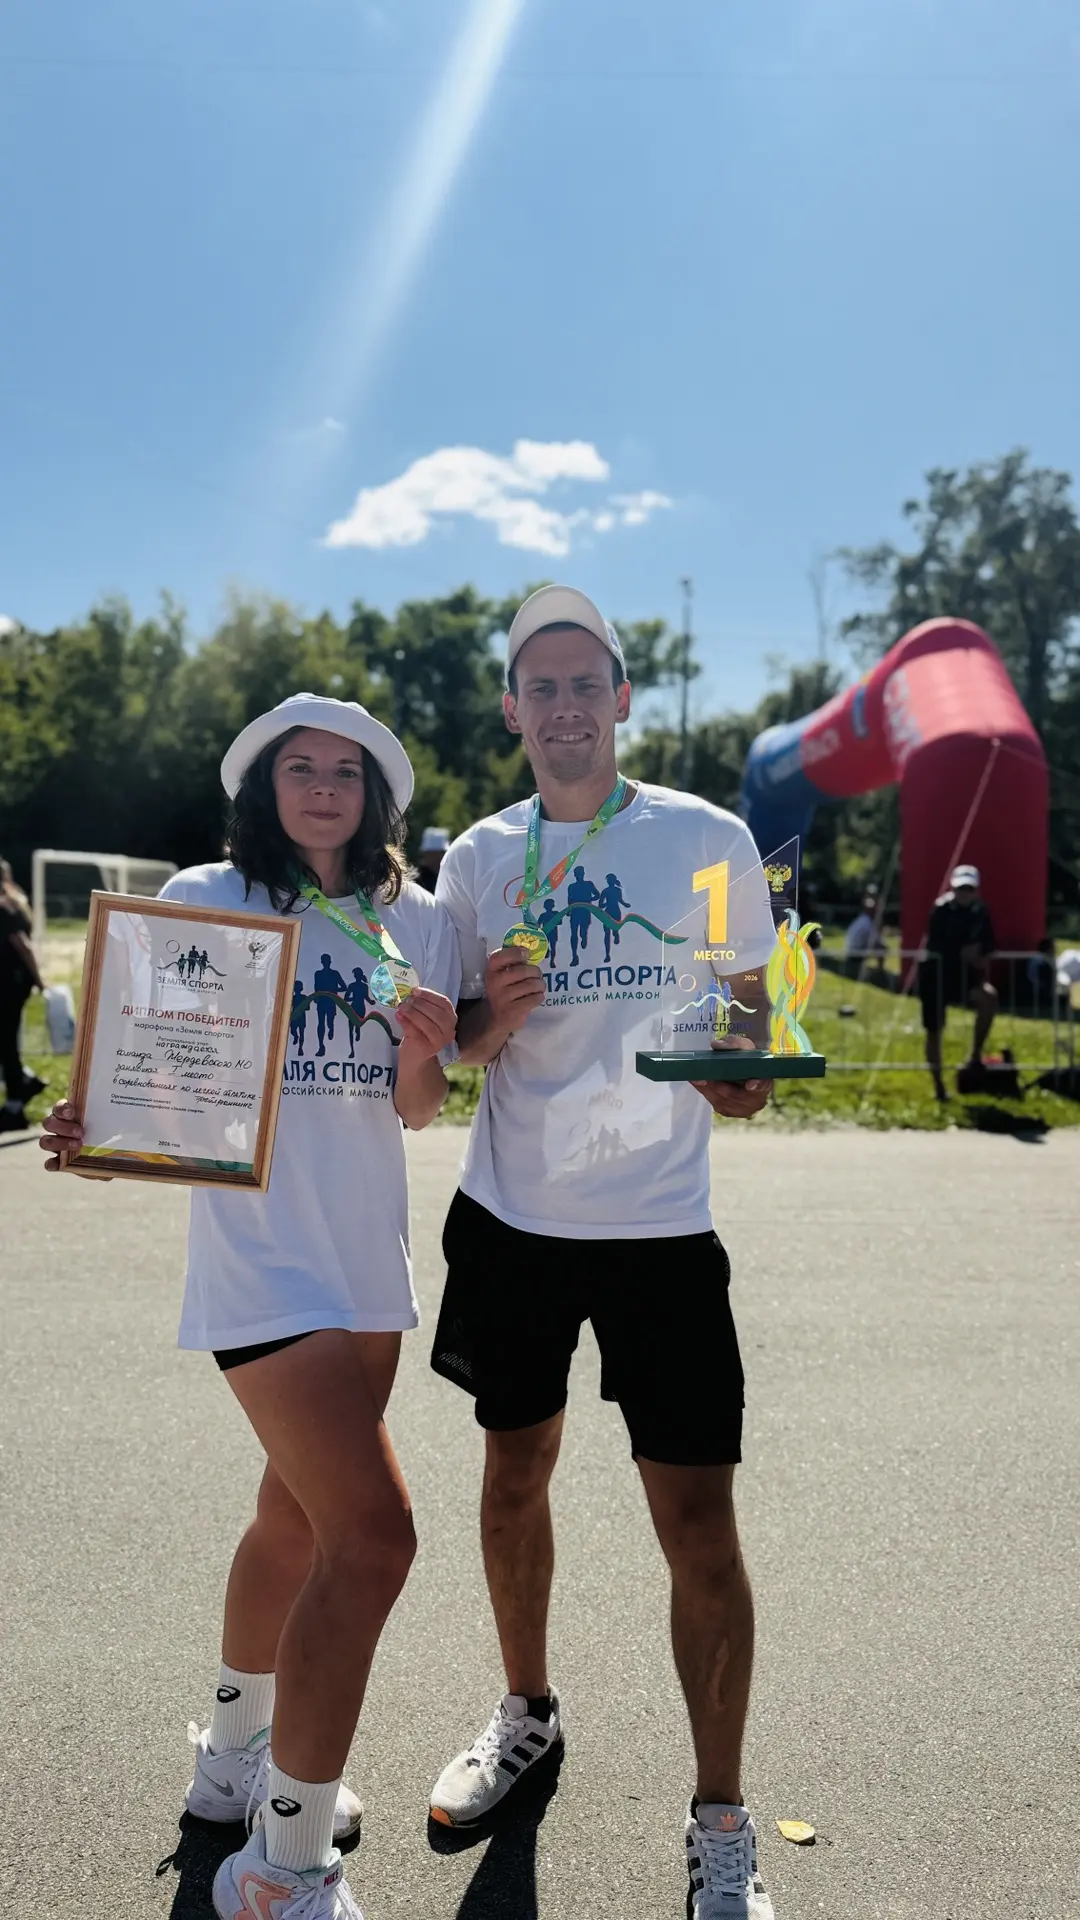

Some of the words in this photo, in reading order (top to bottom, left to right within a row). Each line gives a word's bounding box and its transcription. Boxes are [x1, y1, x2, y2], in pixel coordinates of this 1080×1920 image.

[692, 860, 730, 944] 1
[693, 950, 736, 961] МЕСТО
[157, 976, 187, 986] ЗЕМЛЯ
[188, 980, 224, 991] СПОРТА
[577, 965, 677, 989] СПОРТА
[540, 992, 599, 1007] СИЙСКИЙ
[605, 991, 660, 1000] МАРАФОН
[121, 1005, 174, 1020] ДИПЛОМ
[177, 1011, 250, 1028] ПОБЕДИТЕЛЯ
[134, 1022, 174, 1032] марафона
[175, 1026, 202, 1035] «Земля
[204, 1030, 234, 1039] спорта»
[672, 1023, 709, 1033] ЗЕМЛЯ
[116, 1048, 152, 1060] команда
[156, 1041, 220, 1054] награждается
[181, 1071, 214, 1080] место
[322, 1061, 393, 1087] СПОРТ
[181, 1085, 191, 1093] по
[282, 1084, 344, 1096] ОССИЙСКИЙ
[323, 1868, 339, 1888] NIKE
